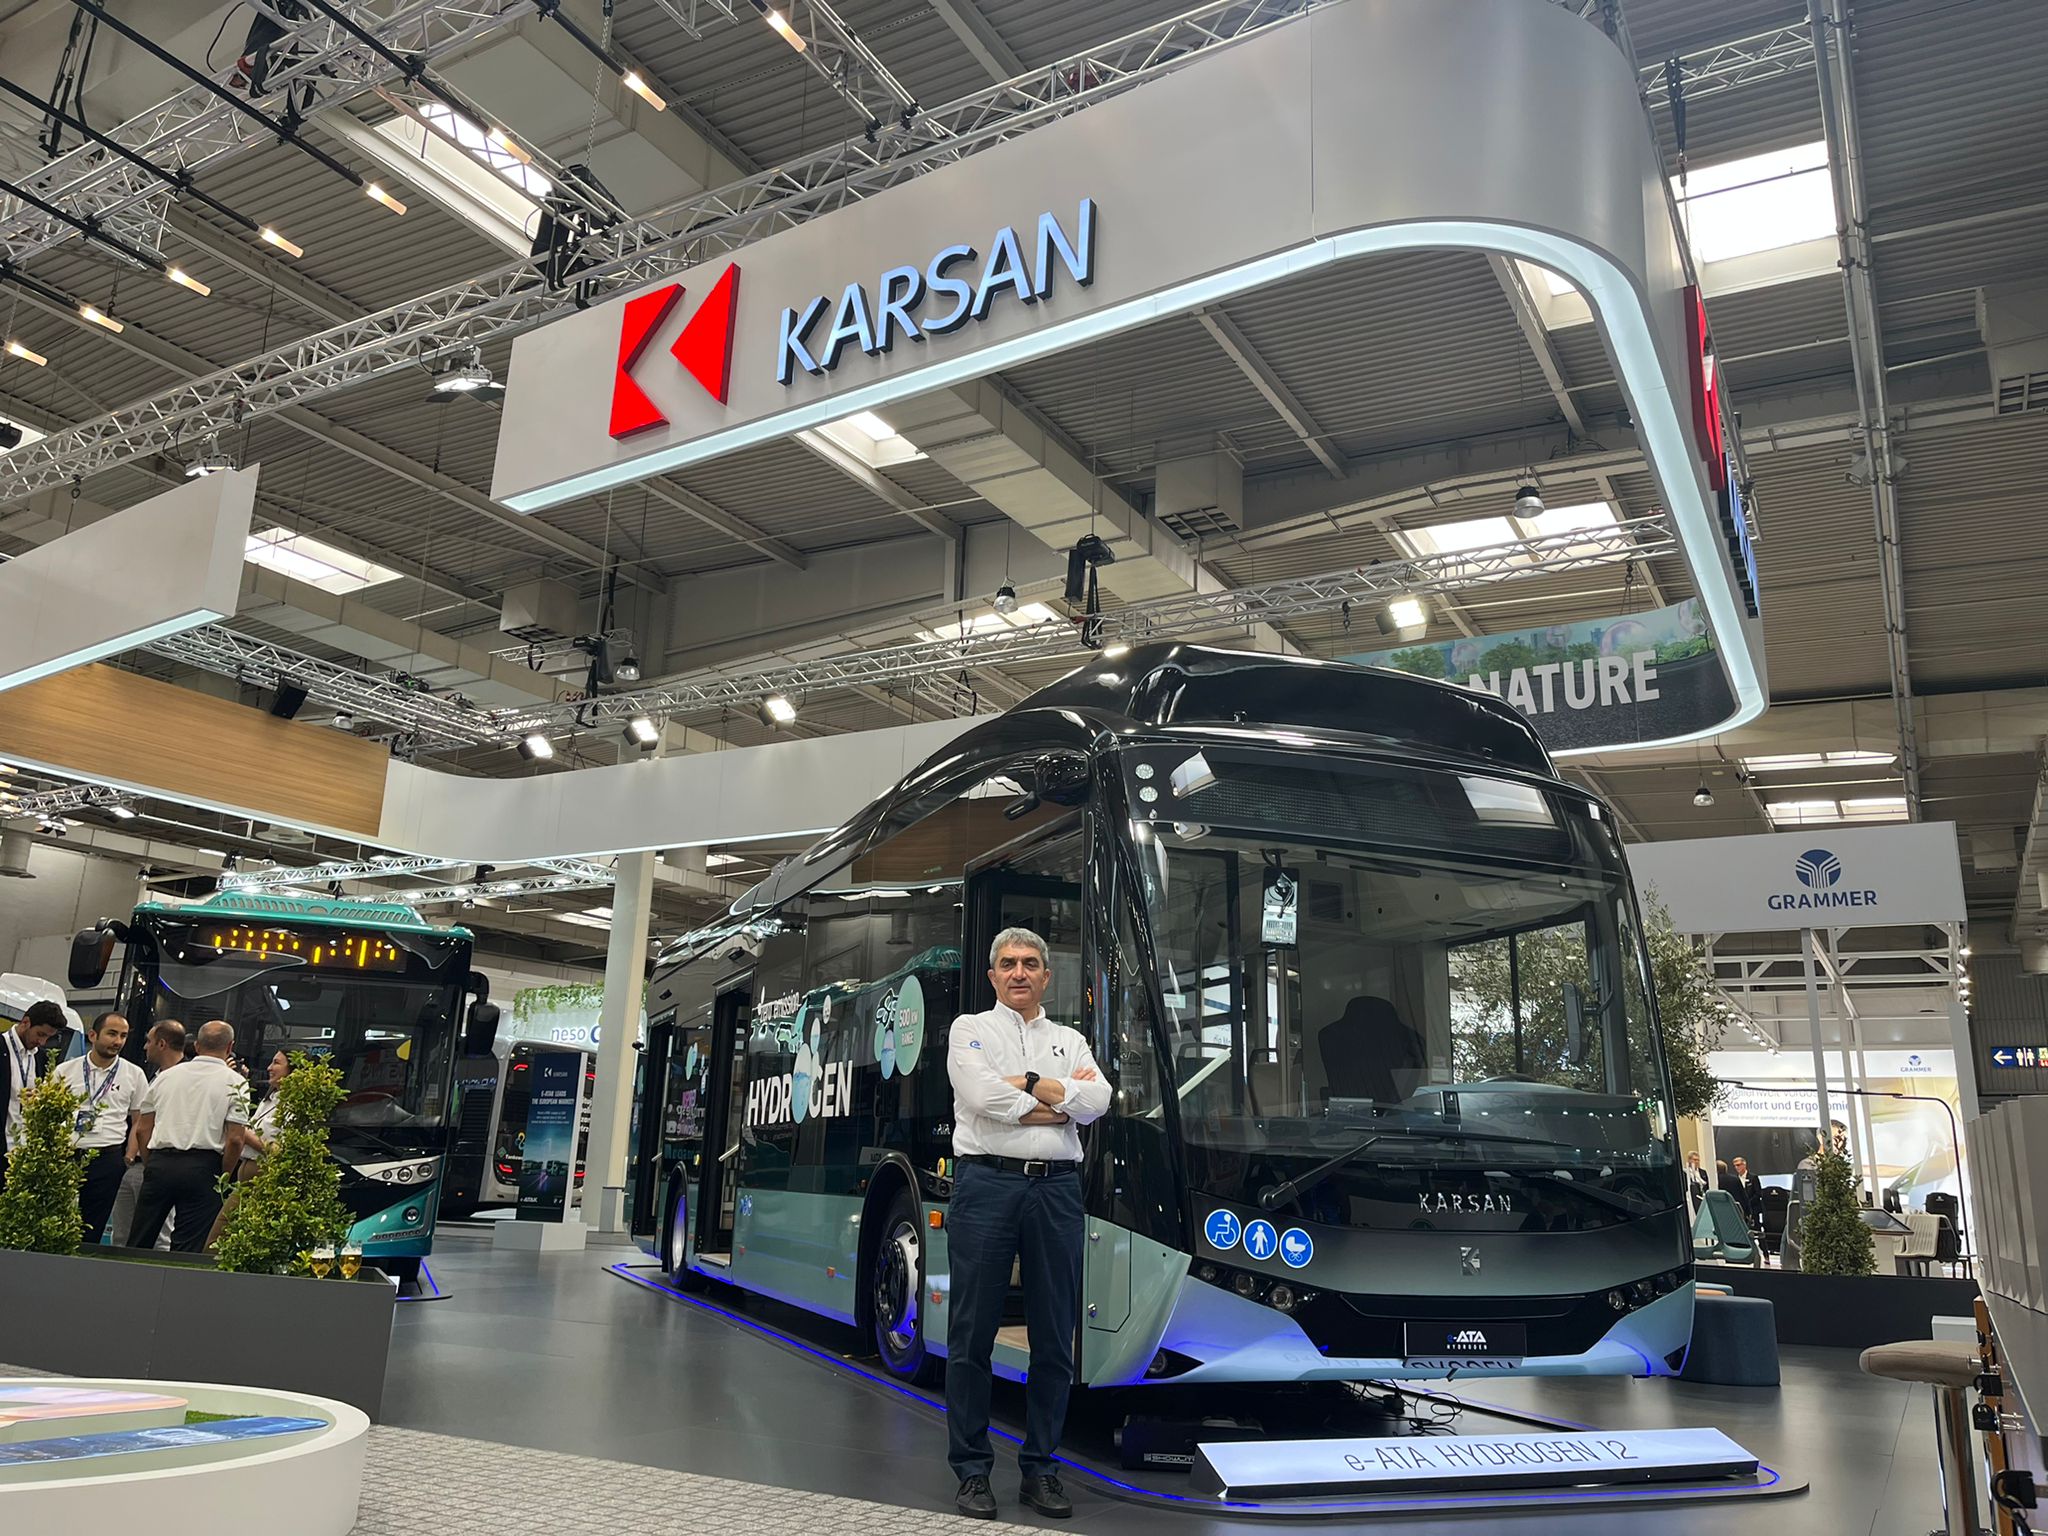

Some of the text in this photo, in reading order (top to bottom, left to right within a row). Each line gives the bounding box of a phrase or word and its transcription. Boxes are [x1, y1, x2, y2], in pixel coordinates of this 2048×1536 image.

[776, 198, 1097, 386] KARSAN
[1767, 890, 1878, 910] GRAMMER
[551, 1028, 586, 1042] neso
[746, 1051, 853, 1126] HYDROGEN
[1728, 1101, 1769, 1111] Komfort
[1771, 1101, 1792, 1111] und
[1418, 1192, 1512, 1214] KARSAN
[1447, 1330, 1487, 1344] e-ATA
[1344, 1440, 1638, 1472] e-ATA HYDROGEN 12
